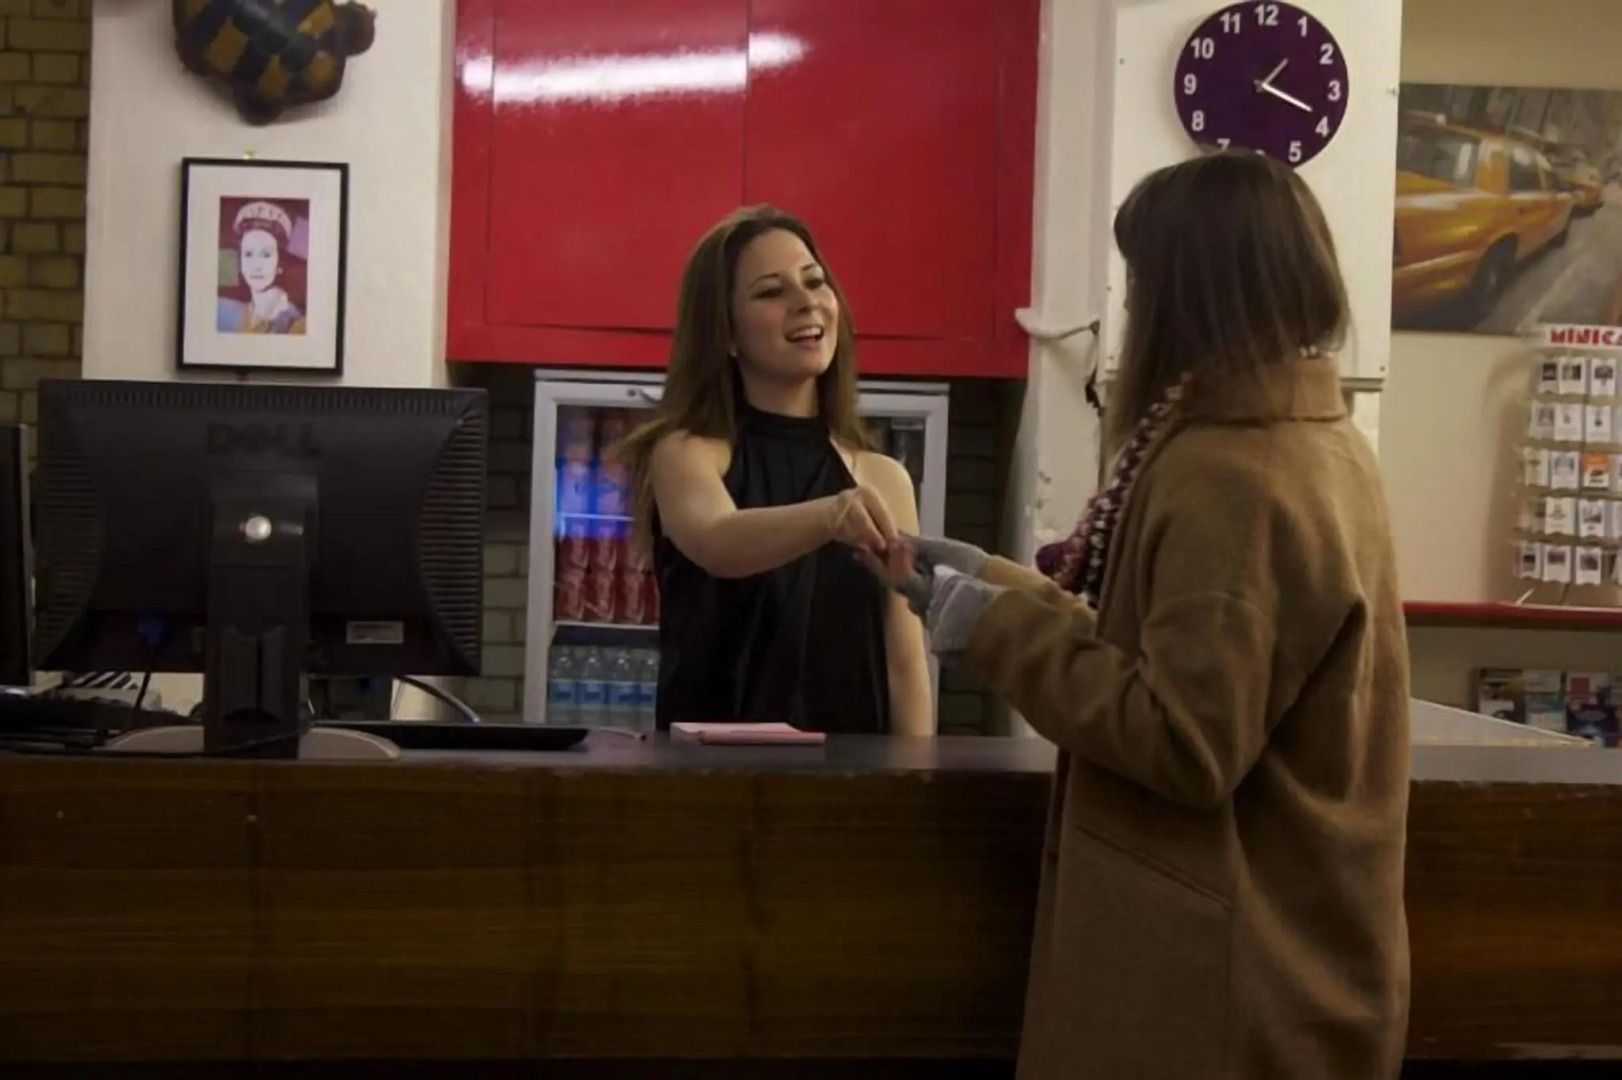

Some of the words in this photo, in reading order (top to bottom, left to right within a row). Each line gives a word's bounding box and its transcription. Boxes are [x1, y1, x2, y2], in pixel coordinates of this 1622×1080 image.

[1220, 12, 1241, 34] 11
[1255, 4, 1279, 26] 12
[1298, 16, 1308, 37] 1
[1190, 37, 1215, 59] 10
[1319, 43, 1334, 64] 2
[1184, 73, 1197, 95] 9
[1327, 80, 1341, 101] 3
[1191, 110, 1205, 131] 8
[1315, 116, 1330, 137] 4
[1288, 141, 1302, 162] 5
